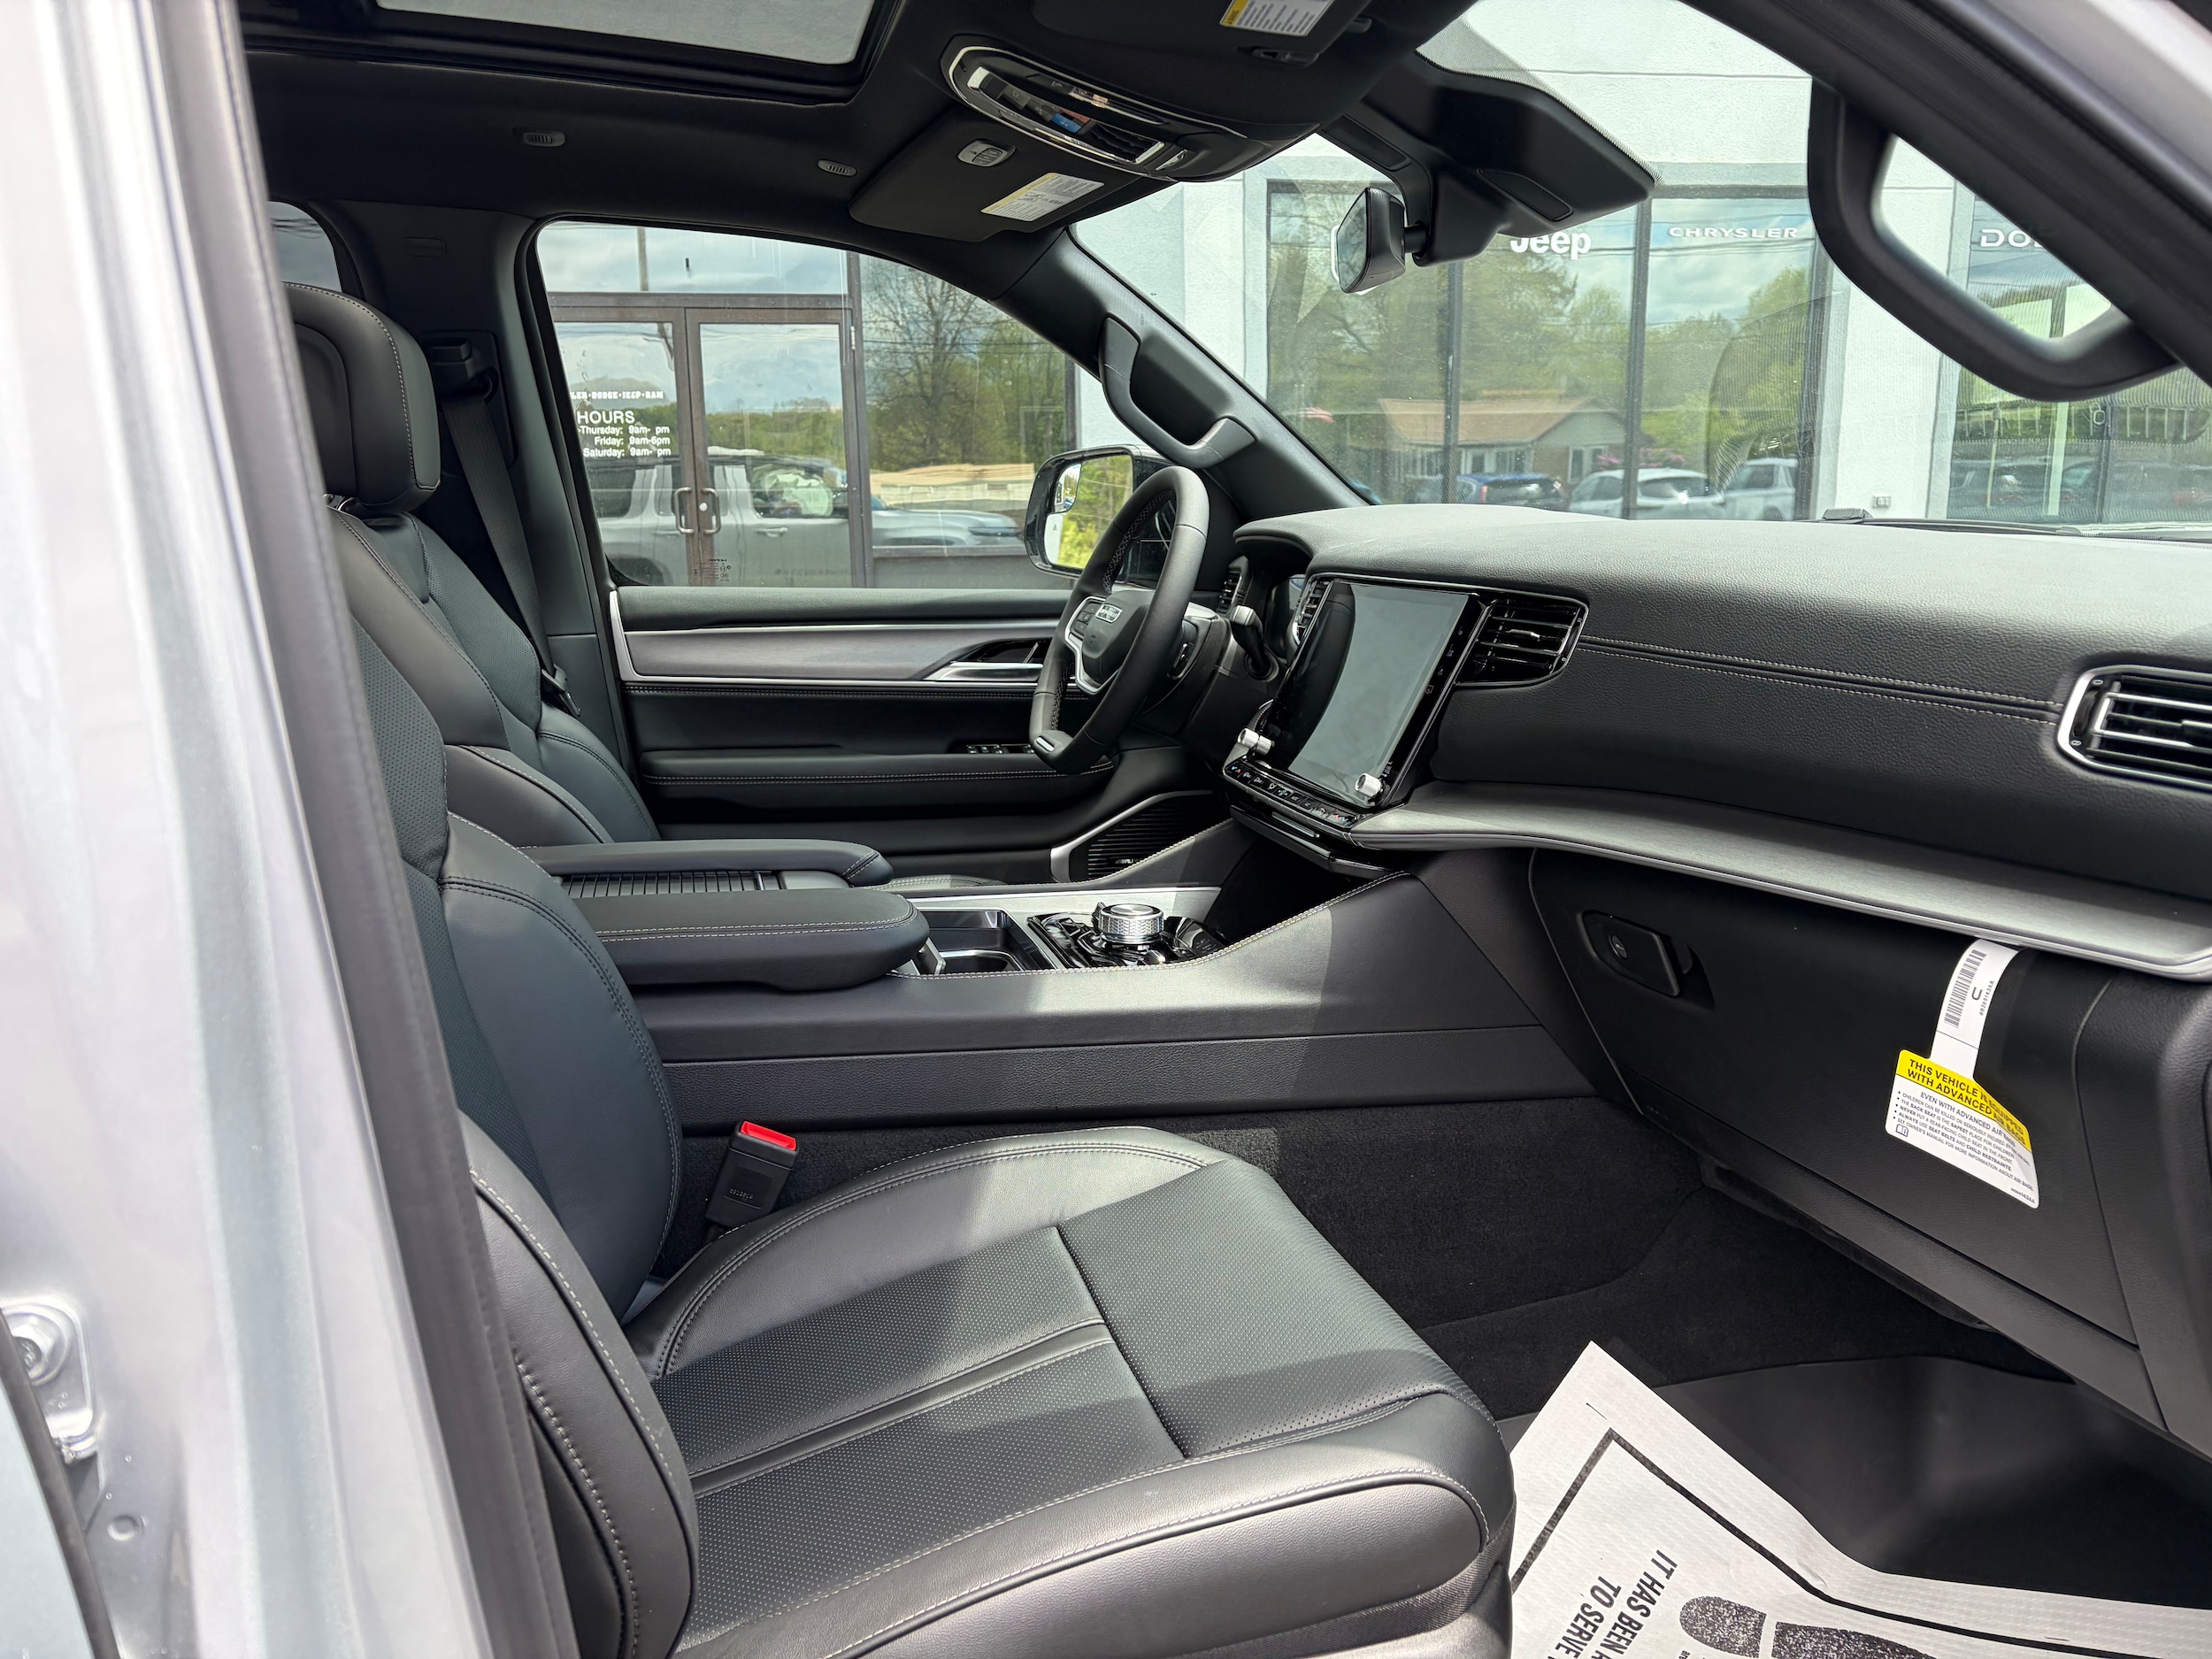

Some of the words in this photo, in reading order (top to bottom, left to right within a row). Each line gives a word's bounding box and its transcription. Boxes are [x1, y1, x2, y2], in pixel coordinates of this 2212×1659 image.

[1669, 227, 1798, 238] CHRYSLER
[1980, 229, 2043, 247] DO
[577, 411, 635, 424] HOURS
[583, 448, 625, 458] Saturday:
[595, 436, 624, 447] Friday:
[1907, 1068, 1933, 1087] WITH
[1936, 1081, 1992, 1115] ADVANCED
[1909, 1058, 1932, 1075] THIS
[1934, 1070, 1978, 1097] VEHICLE
[1900, 1104, 1916, 1116] NEVER
[1957, 1133, 1970, 1142] CHILD
[1902, 1092, 1924, 1105] CHILDREN
[1940, 1110, 1955, 1121] KILLED
[1910, 1102, 1923, 1112] BACK
[1924, 1109, 1935, 1118] SEAT
[1969, 1131, 1982, 1141] PLACE
[1920, 1091, 1937, 1103] EVEN
[1938, 1100, 1955, 1112] WITH
[1956, 1109, 1990, 1130] ADVANCED
[1992, 1126, 2002, 1136] AIR
[1898, 1111, 1917, 1124] ALWAYS
[1928, 1125, 1939, 1134] SEAT
[1940, 1132, 1955, 1141] BELTS
[1966, 1144, 1981, 1155] CHILD
[1926, 1131, 1944, 1143] MANUAL
[1955, 1145, 1967, 1155] MORE
[1968, 1152, 1998, 1171] INFORMATION
[1651, 1550, 1678, 1580] IT
[1590, 1576, 1622, 1609] TO
[1626, 1571, 1665, 1617] HAS
[1555, 1602, 1604, 1659] SERVE
[1600, 1611, 1643, 1655] BEEN
